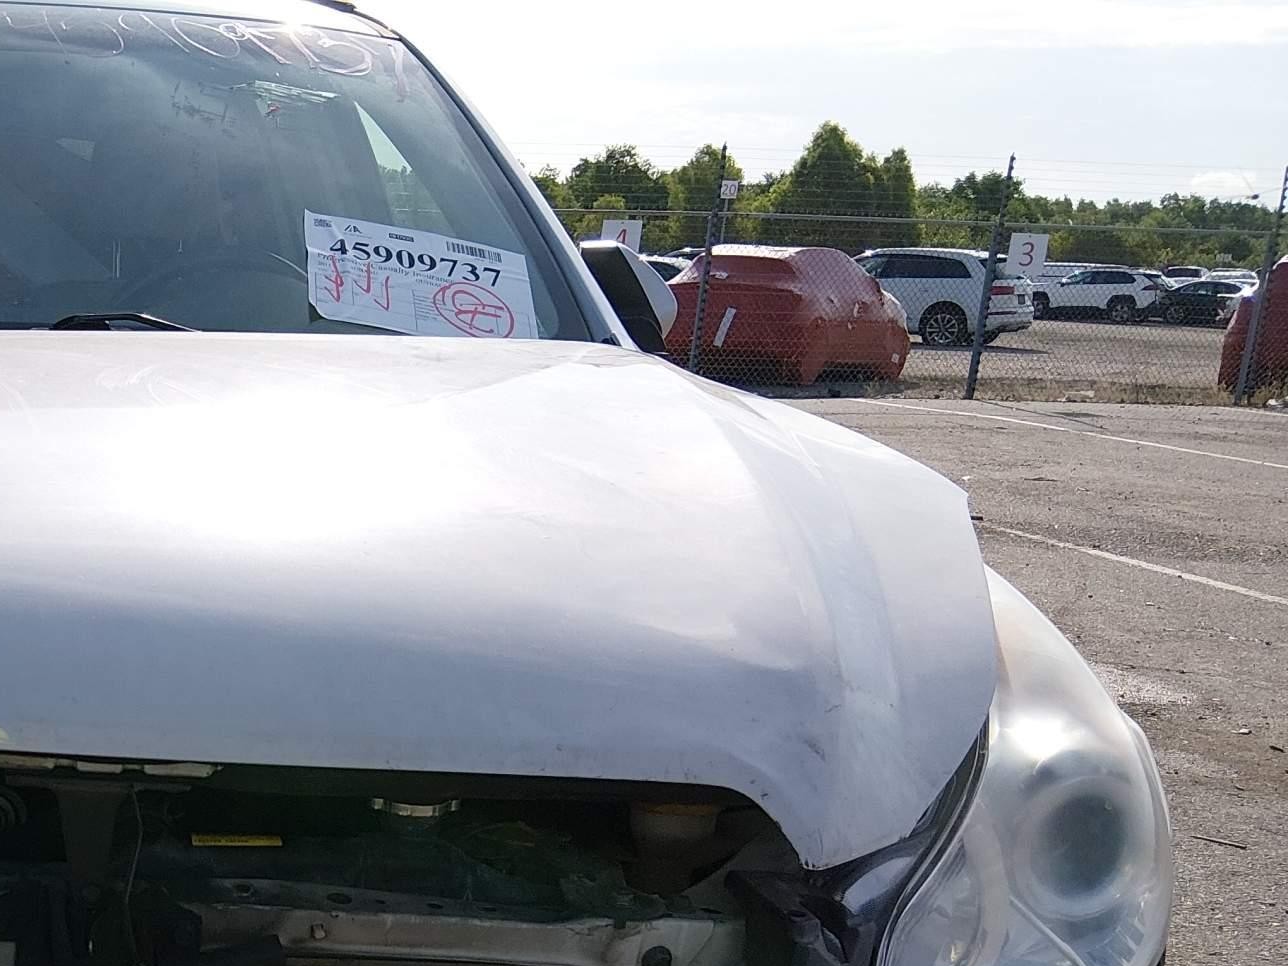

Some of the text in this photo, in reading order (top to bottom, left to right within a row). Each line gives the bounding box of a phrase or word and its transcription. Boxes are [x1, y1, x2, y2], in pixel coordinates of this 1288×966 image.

[722, 184, 737, 196] 20
[329, 238, 501, 287] 45909737
[1018, 241, 1035, 267] 3
